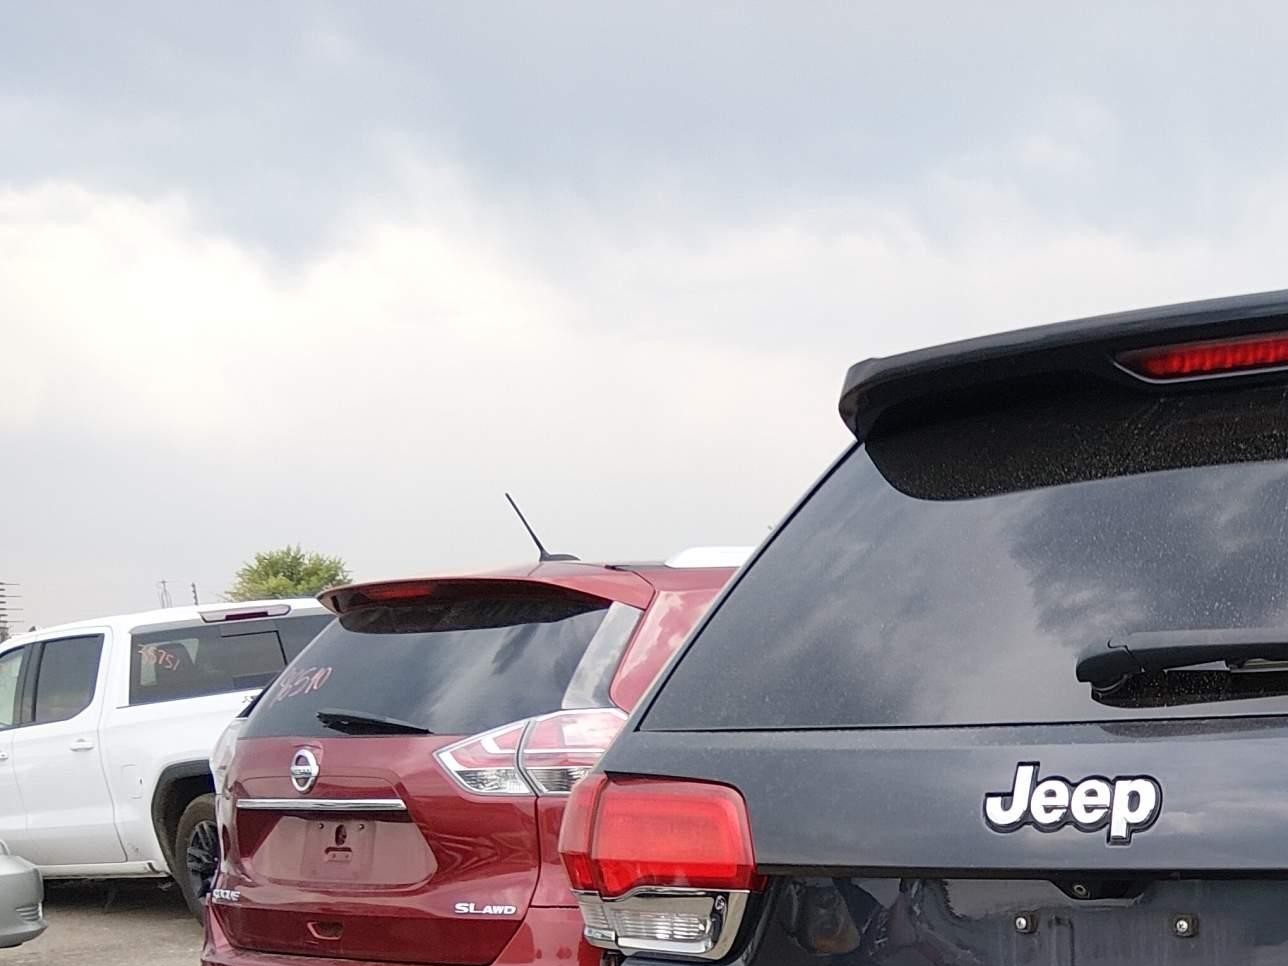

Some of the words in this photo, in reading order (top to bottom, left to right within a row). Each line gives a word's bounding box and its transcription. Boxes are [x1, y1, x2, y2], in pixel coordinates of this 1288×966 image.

[983, 762, 1163, 845] Jeep
[455, 903, 482, 913] SL
[482, 905, 516, 915] AWD
